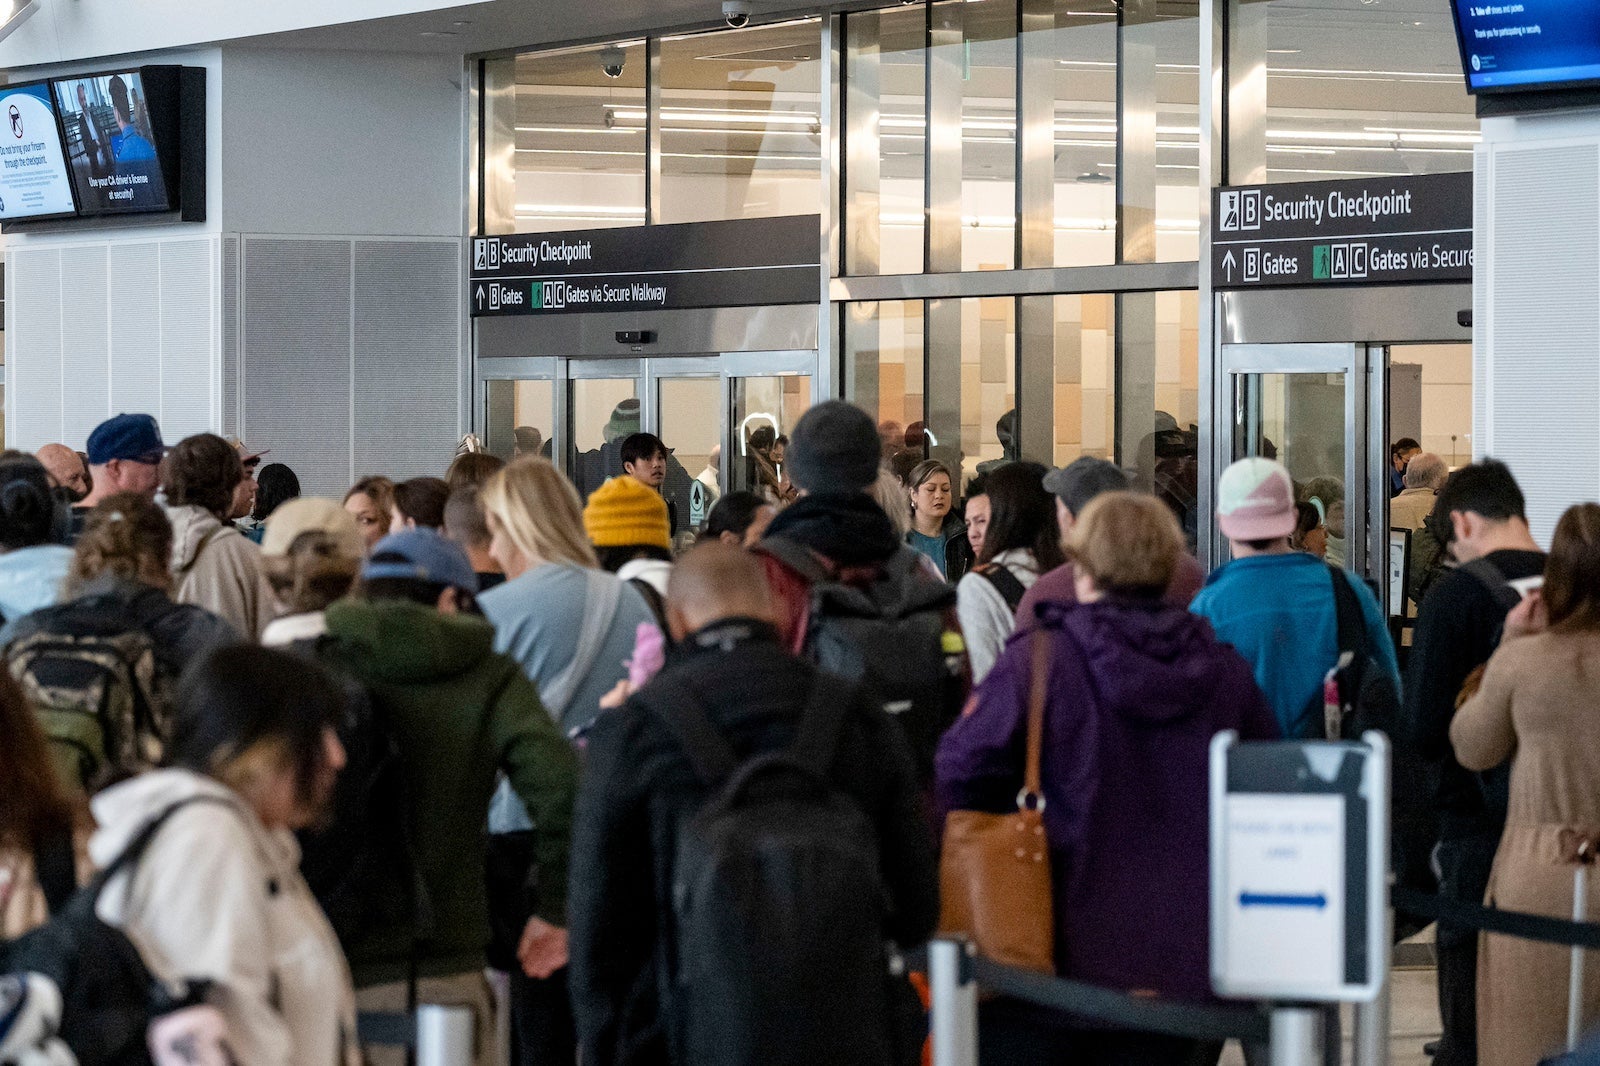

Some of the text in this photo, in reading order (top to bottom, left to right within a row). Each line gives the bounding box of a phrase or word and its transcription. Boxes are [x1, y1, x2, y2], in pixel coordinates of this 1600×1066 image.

[88, 176, 98, 187] Use
[98, 178, 108, 188] your
[108, 175, 116, 186] CA
[131, 173, 148, 184] license
[109, 188, 134, 200] at security?
[1264, 195, 1325, 225] Security
[1328, 189, 1412, 222] Checkpoint
[501, 243, 539, 266] Security
[540, 240, 592, 265] Checkpoint
[1263, 252, 1298, 275] Gates
[1370, 247, 1407, 270] Gates
[1410, 246, 1429, 268] via
[1431, 244, 1474, 267] Secure
[501, 286, 523, 305] Gates
[566, 284, 589, 303] Gates
[590, 286, 601, 302] via
[602, 284, 630, 302] Secure
[631, 282, 667, 305] Walkway
